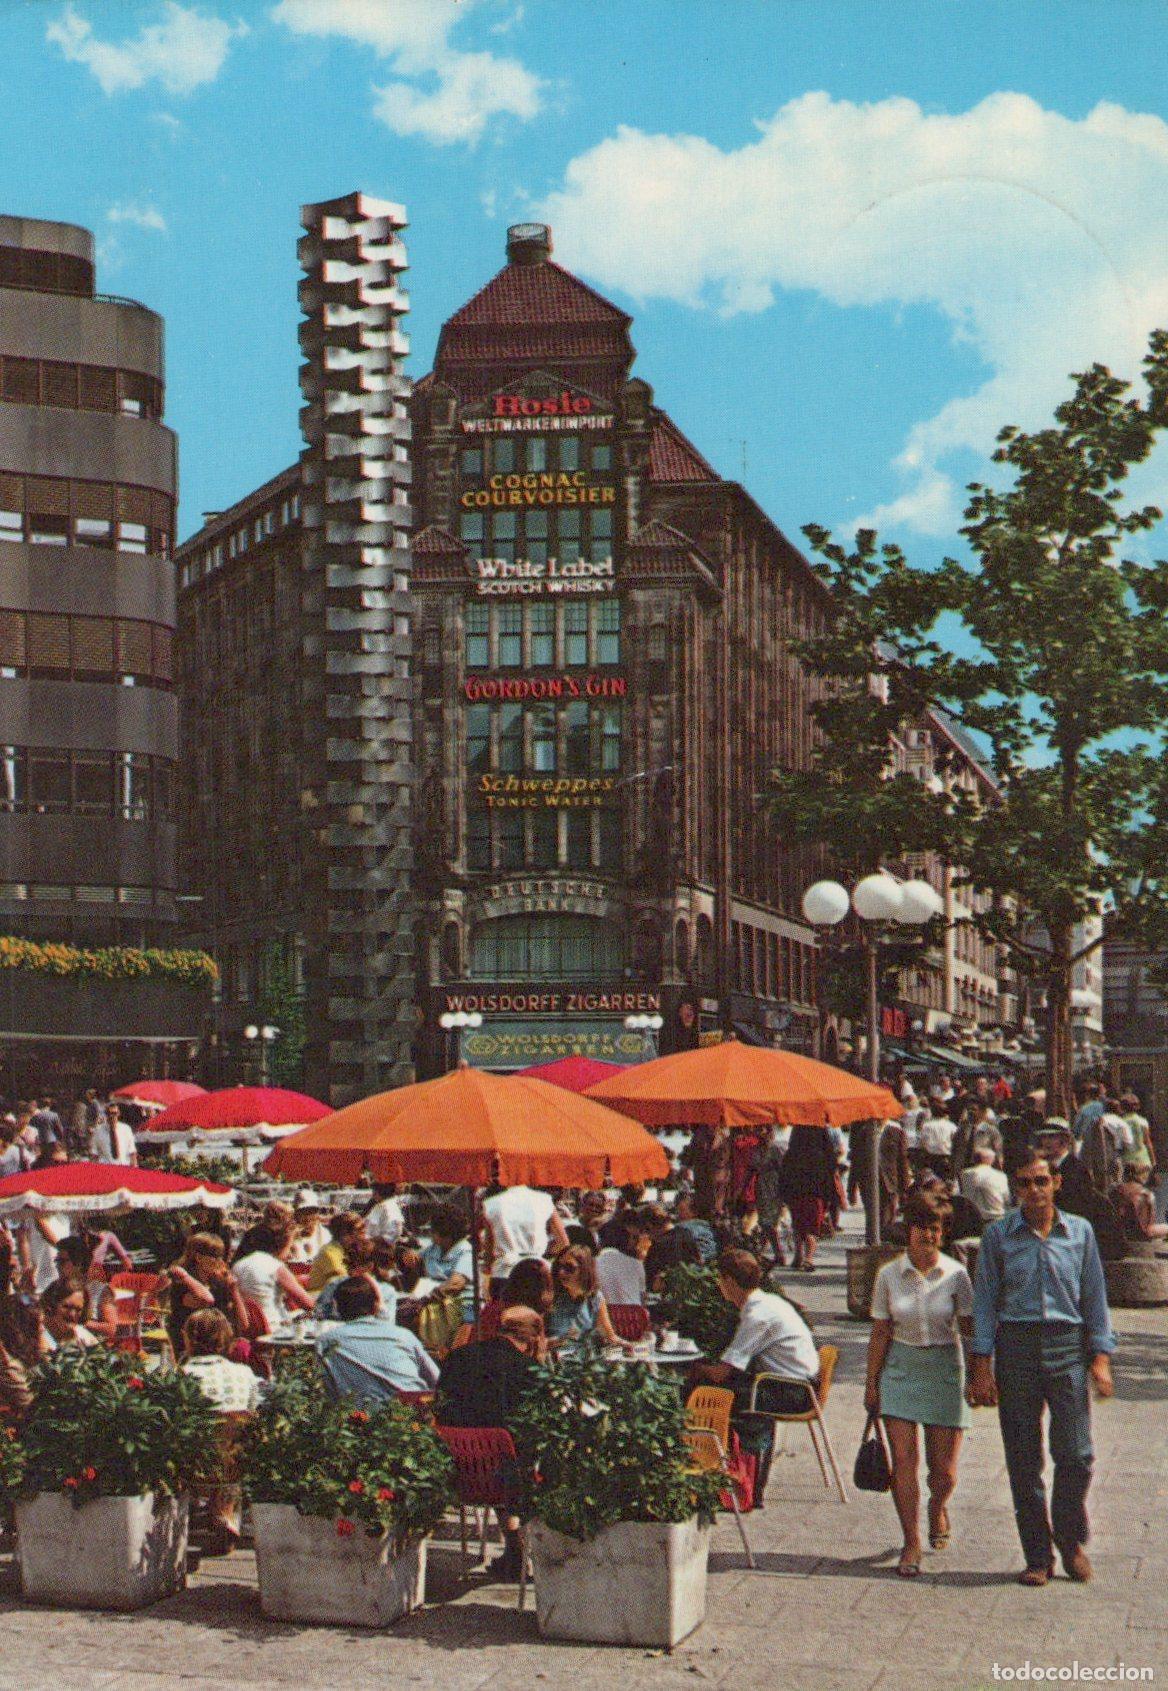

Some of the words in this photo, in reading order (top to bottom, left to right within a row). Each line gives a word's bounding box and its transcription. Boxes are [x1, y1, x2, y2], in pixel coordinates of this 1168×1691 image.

[490, 472, 588, 489] COGNAC
[461, 487, 616, 507] COURVOISIER
[476, 558, 545, 578] White
[548, 556, 614, 577] Label
[476, 580, 542, 595] SCOTCH
[546, 579, 615, 594] WHISKY
[479, 774, 616, 793] Schweppes
[486, 796, 538, 808] TONIC
[544, 796, 603, 808] WATER
[446, 993, 560, 1013] WOLSDORFF
[565, 993, 661, 1011] ZIGARREN
[497, 1033, 612, 1044] WOLSDORFF
